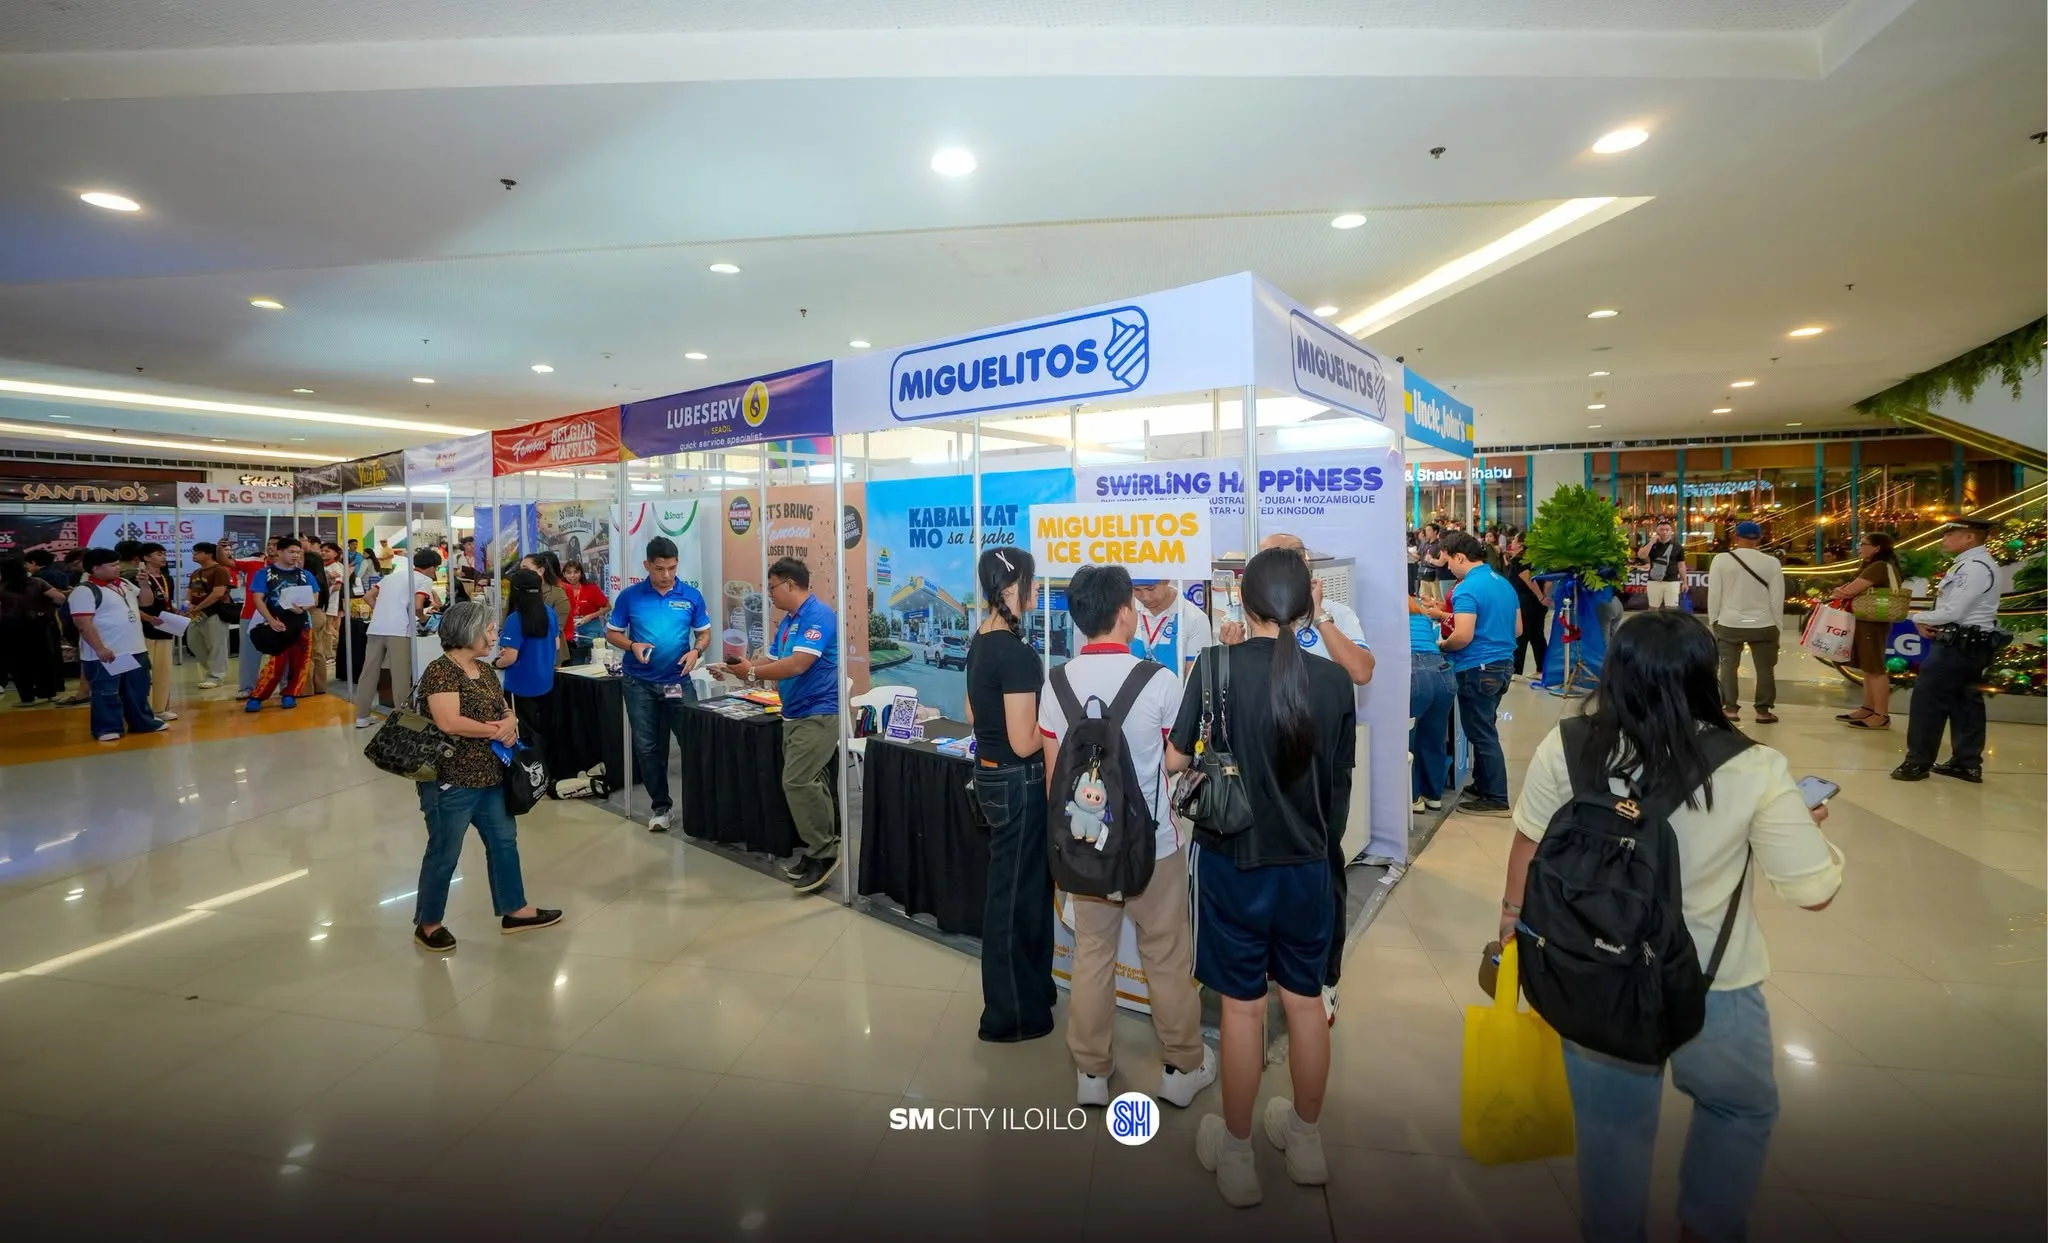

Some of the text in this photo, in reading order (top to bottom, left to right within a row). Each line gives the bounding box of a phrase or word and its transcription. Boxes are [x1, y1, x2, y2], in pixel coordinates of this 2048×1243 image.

[900, 339, 1098, 402] MIGUELITOS
[1297, 335, 1374, 399] MIGUELITOS
[667, 397, 740, 429] LUBESERV
[1413, 389, 1466, 443] Uncle John's
[552, 422, 596, 444] BELGIAN
[711, 425, 732, 435] SEAOIL
[512, 439, 547, 462] Famous
[551, 439, 597, 461] WAFFLES
[680, 433, 763, 451] quick service specialist
[1417, 468, 1462, 481] Shabu
[22, 481, 149, 502] SANTINO'S
[206, 489, 253, 504] LT&G
[1265, 496, 1295, 504] DUBAI
[1303, 495, 1375, 505] MOZAMBIQUE
[669, 511, 684, 519] Smart
[783, 503, 814, 521] BRING
[1276, 506, 1325, 515] KINGDOM
[144, 521, 192, 534] LT&G
[1037, 512, 1199, 538] MIGUELITOS
[909, 528, 943, 549] MO
[947, 531, 965, 545] sa
[767, 546, 808, 558] LOSER TO YOU
[1047, 539, 1186, 564] ICE CREAM
[805, 630, 821, 640] STP
[1826, 625, 1848, 638] TGP
